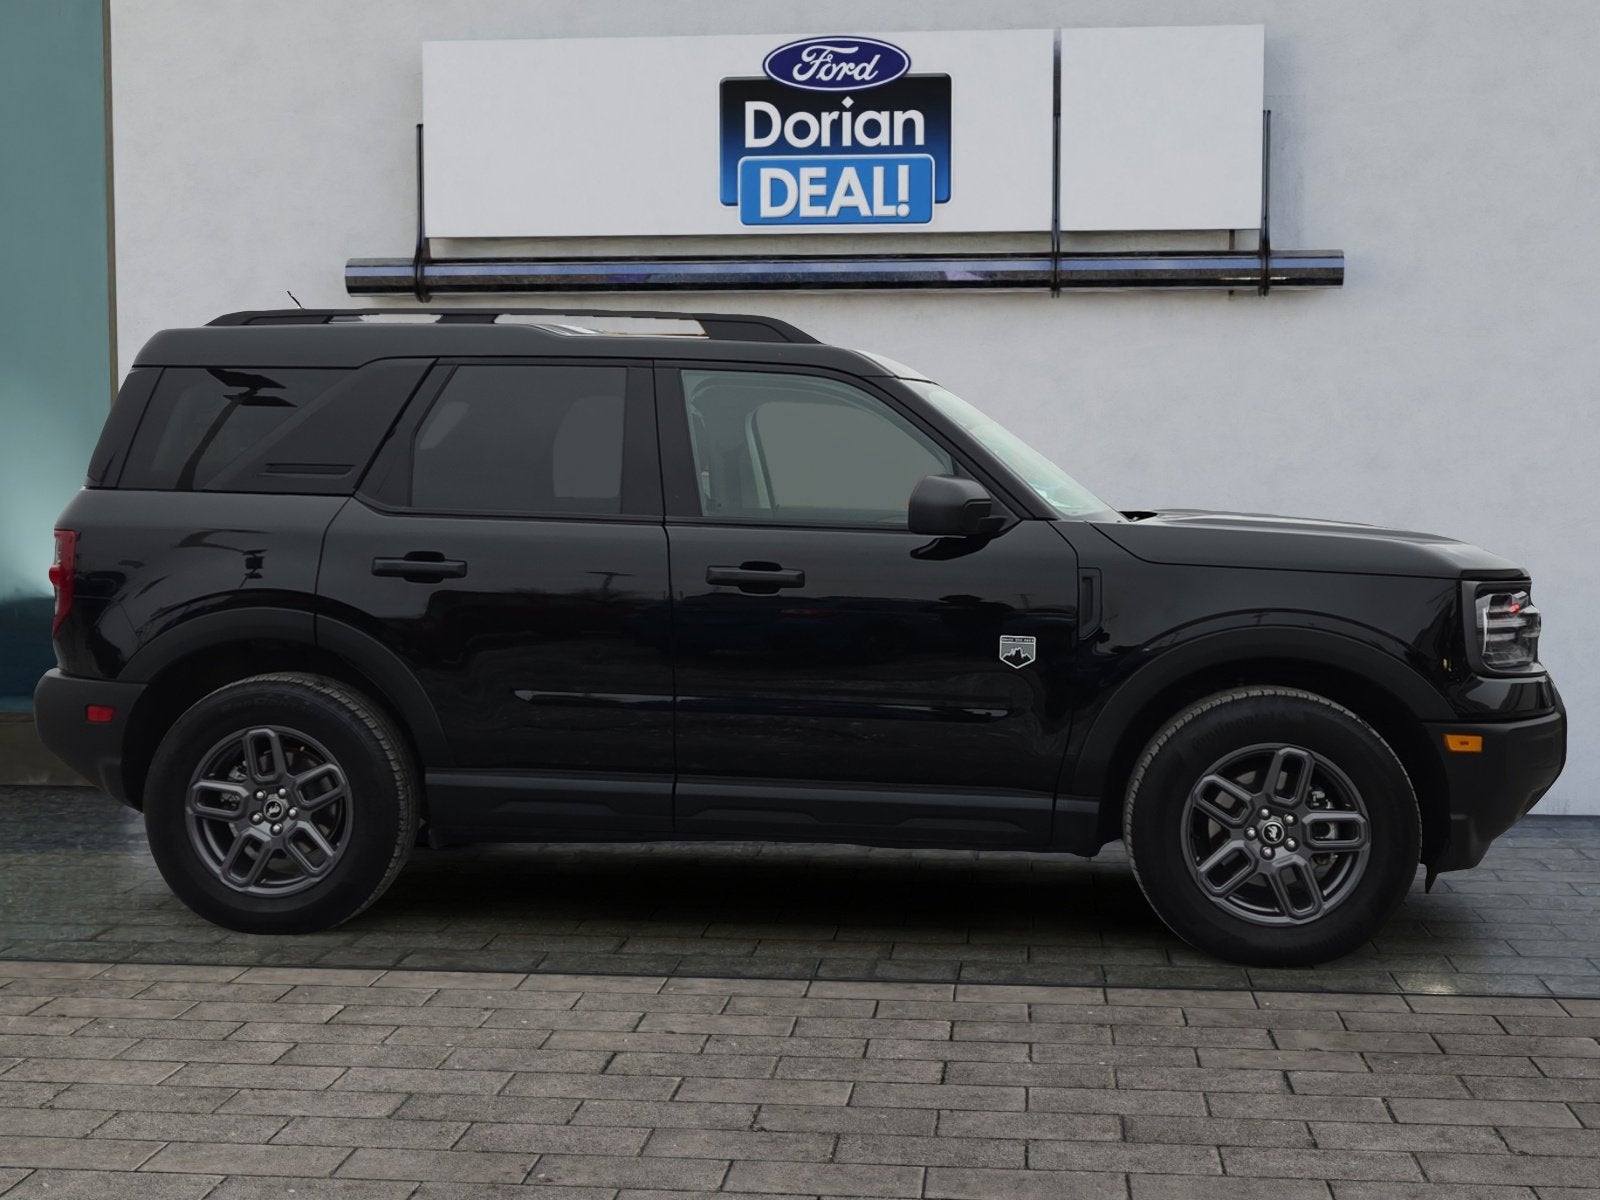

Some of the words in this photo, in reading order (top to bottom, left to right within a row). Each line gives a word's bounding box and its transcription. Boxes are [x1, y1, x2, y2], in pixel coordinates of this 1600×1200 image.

[792, 44, 881, 82] Ford
[744, 96, 925, 149] Dorian
[760, 165, 911, 218] DEAL!
